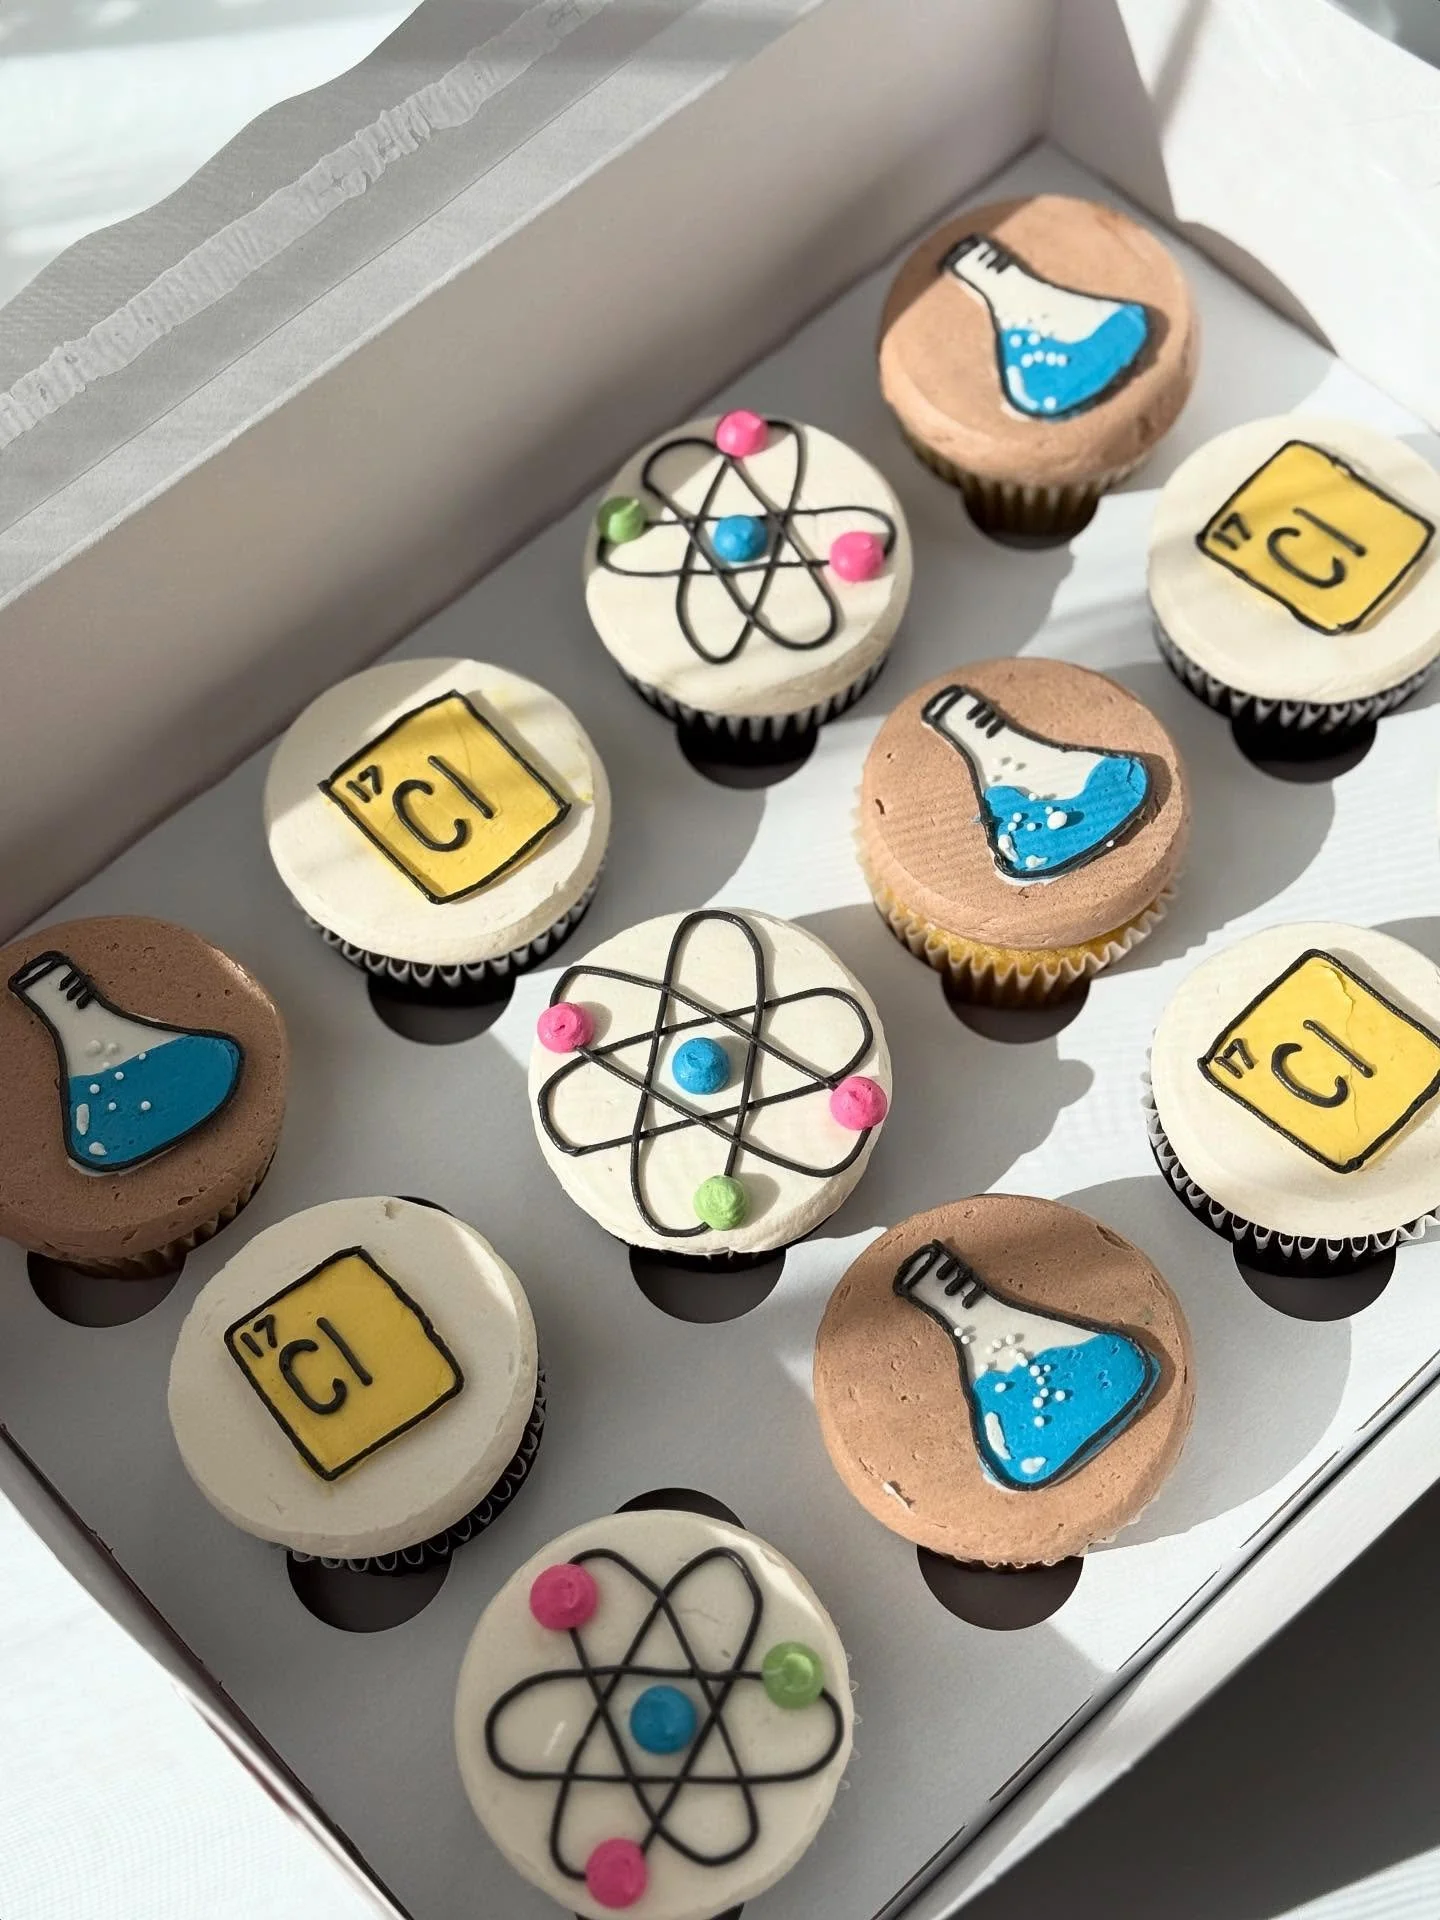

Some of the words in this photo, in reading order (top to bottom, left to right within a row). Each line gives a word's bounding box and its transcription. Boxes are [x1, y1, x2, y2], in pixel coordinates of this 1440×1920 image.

[1211, 512, 1252, 551] 17
[1266, 506, 1368, 589] Cl
[345, 765, 383, 804] 17
[392, 755, 494, 853] Cl
[1214, 1038, 1255, 1079] 17
[1271, 1019, 1374, 1108] Cl
[240, 1314, 278, 1358] 17
[279, 1316, 373, 1416] Cl
